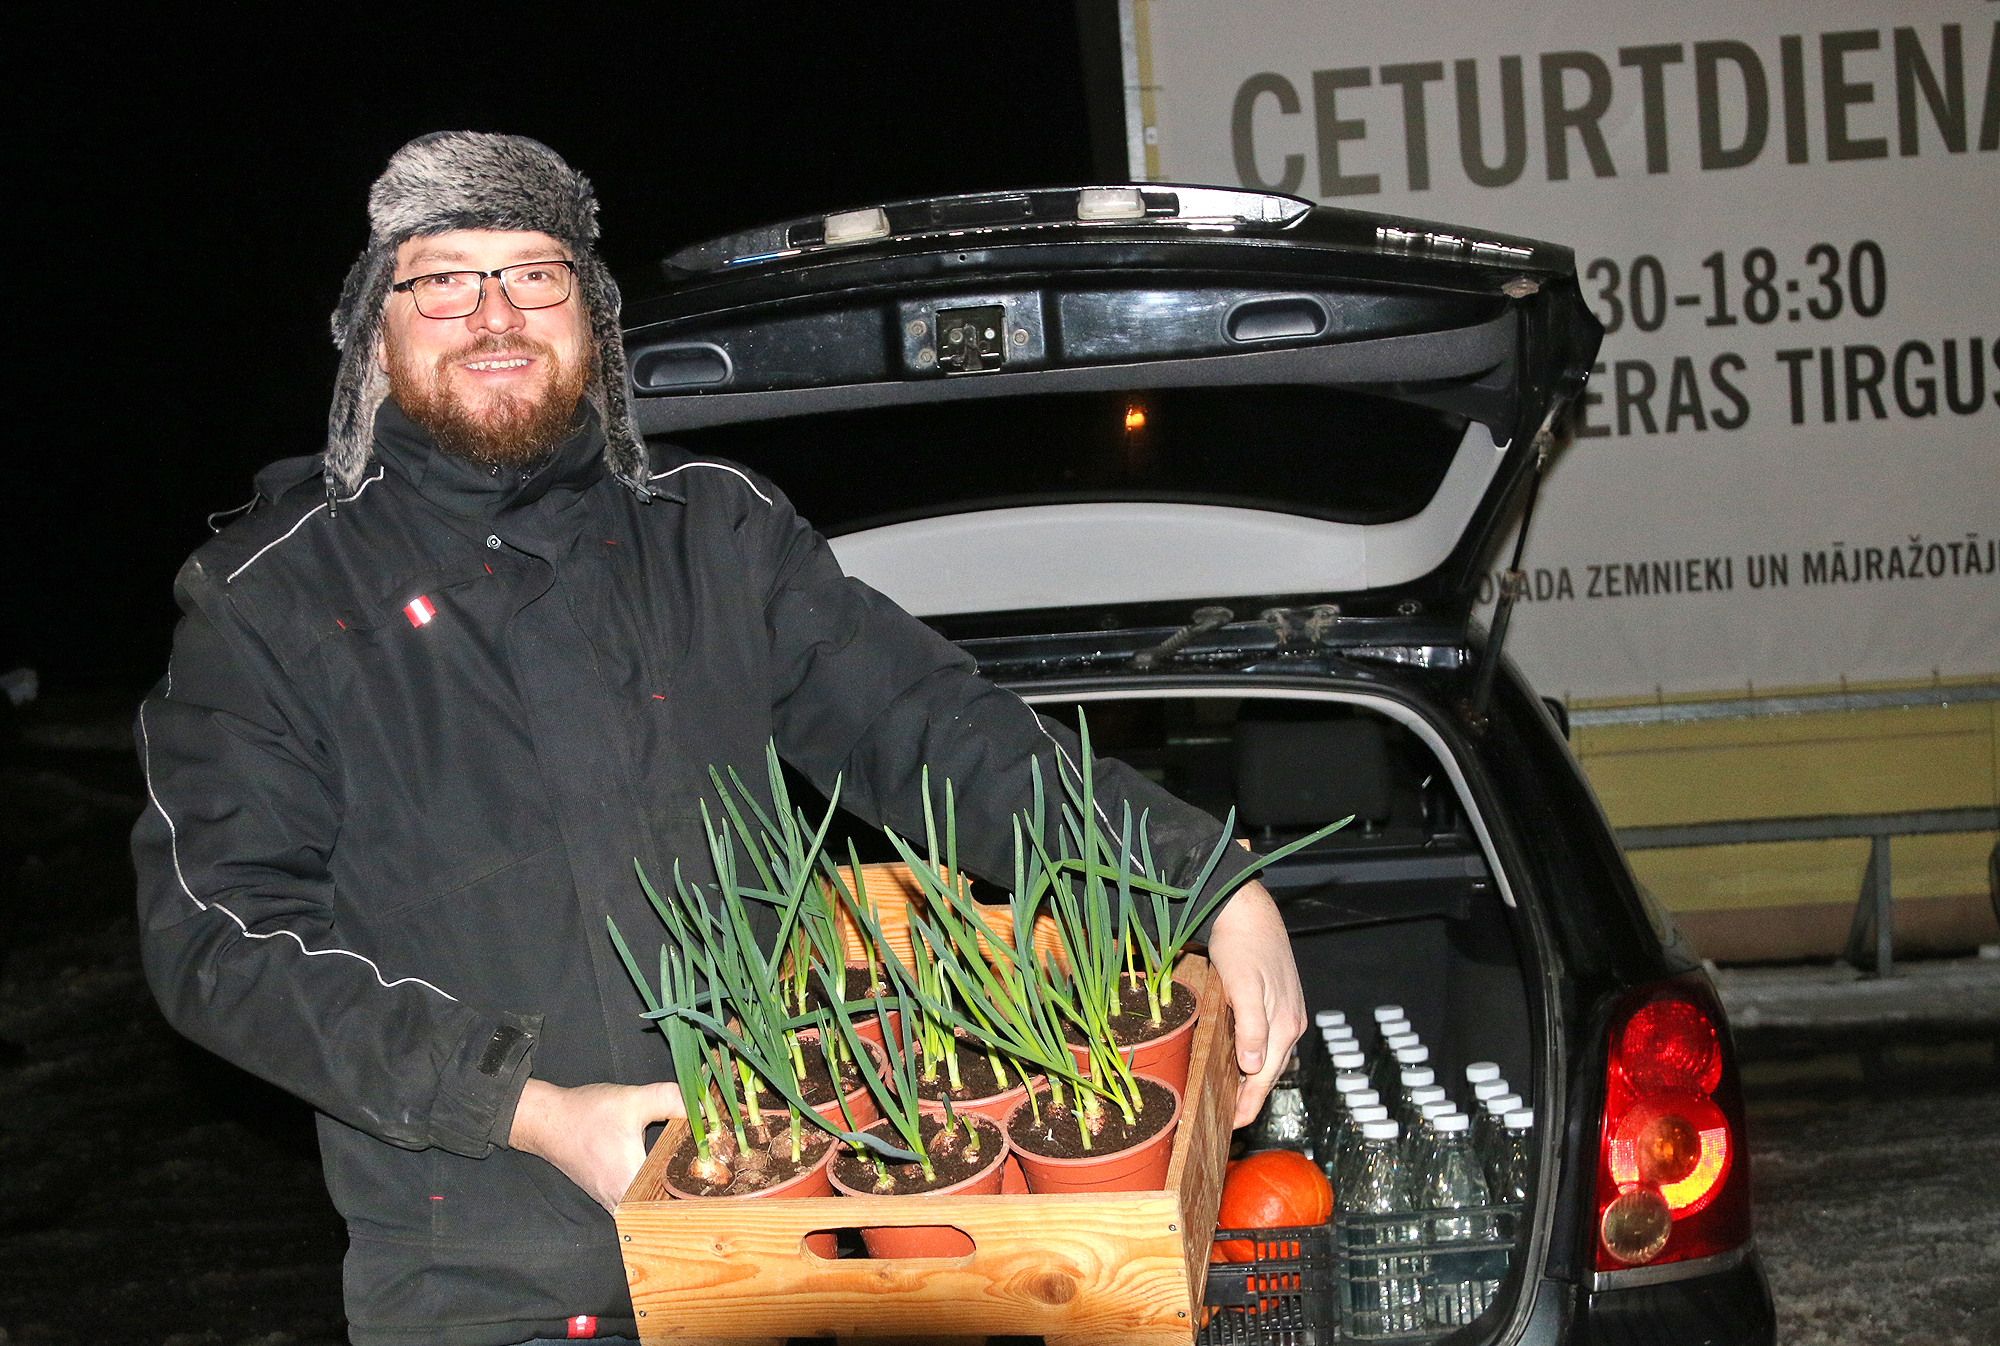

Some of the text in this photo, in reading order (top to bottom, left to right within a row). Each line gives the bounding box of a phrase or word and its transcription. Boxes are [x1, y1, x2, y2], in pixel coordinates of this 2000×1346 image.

[1586, 239, 1888, 334] 30-18:30
[1576, 337, 2000, 438] ERAS TIRGU
[1586, 557, 1733, 599] ZEMNIEKI
[1747, 554, 1790, 589] UN
[1802, 532, 2000, 584] MĀJRAŽOTĀJ
